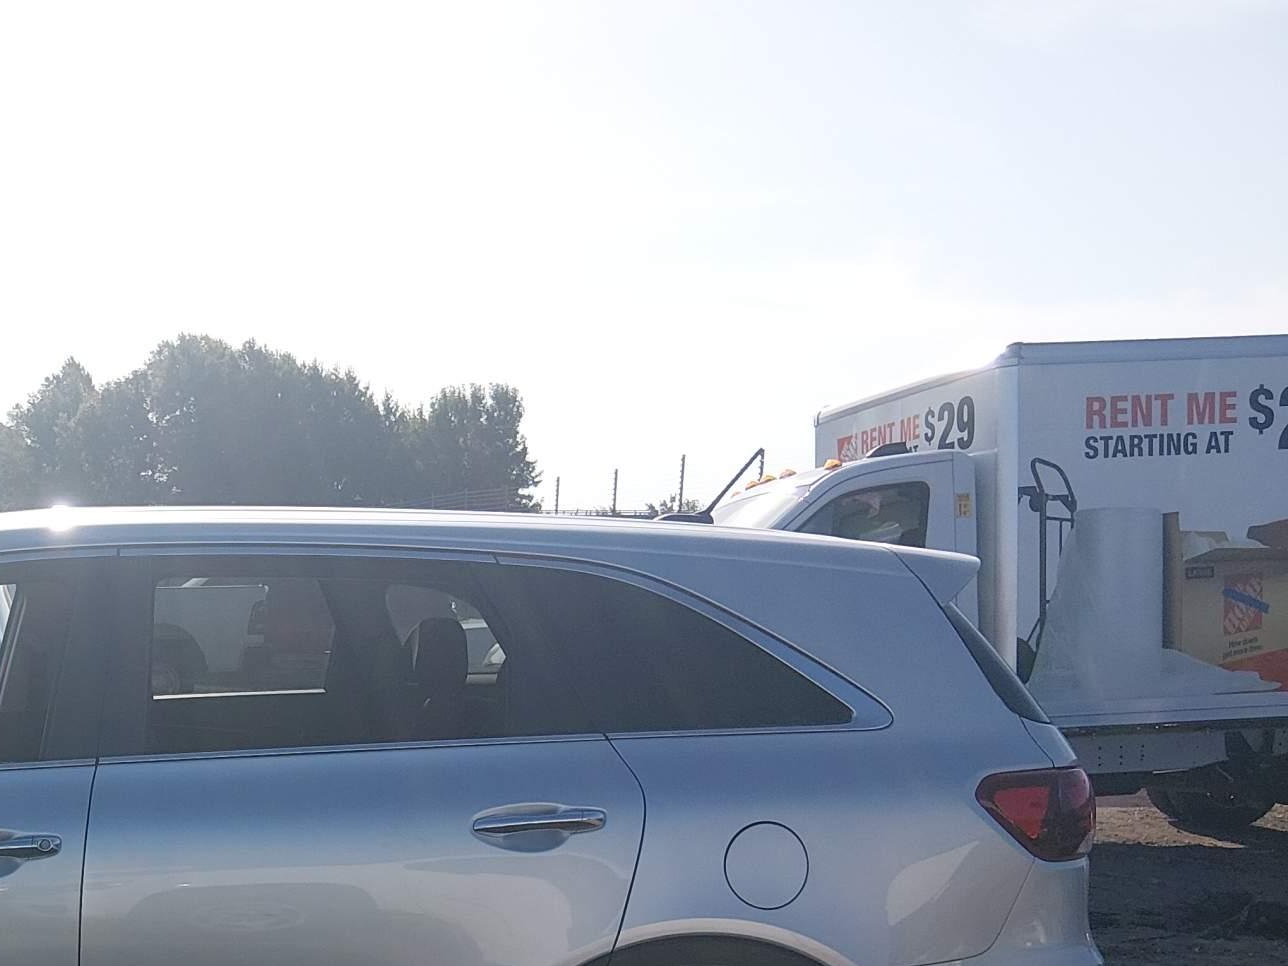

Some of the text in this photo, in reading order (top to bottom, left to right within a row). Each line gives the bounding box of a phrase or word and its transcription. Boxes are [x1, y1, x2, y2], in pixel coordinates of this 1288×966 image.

[924, 395, 975, 450] $29
[1085, 391, 1237, 430] RENT ME
[861, 422, 895, 454] RENT
[900, 415, 920, 442] ME
[1084, 431, 1234, 459] STARTING AT
